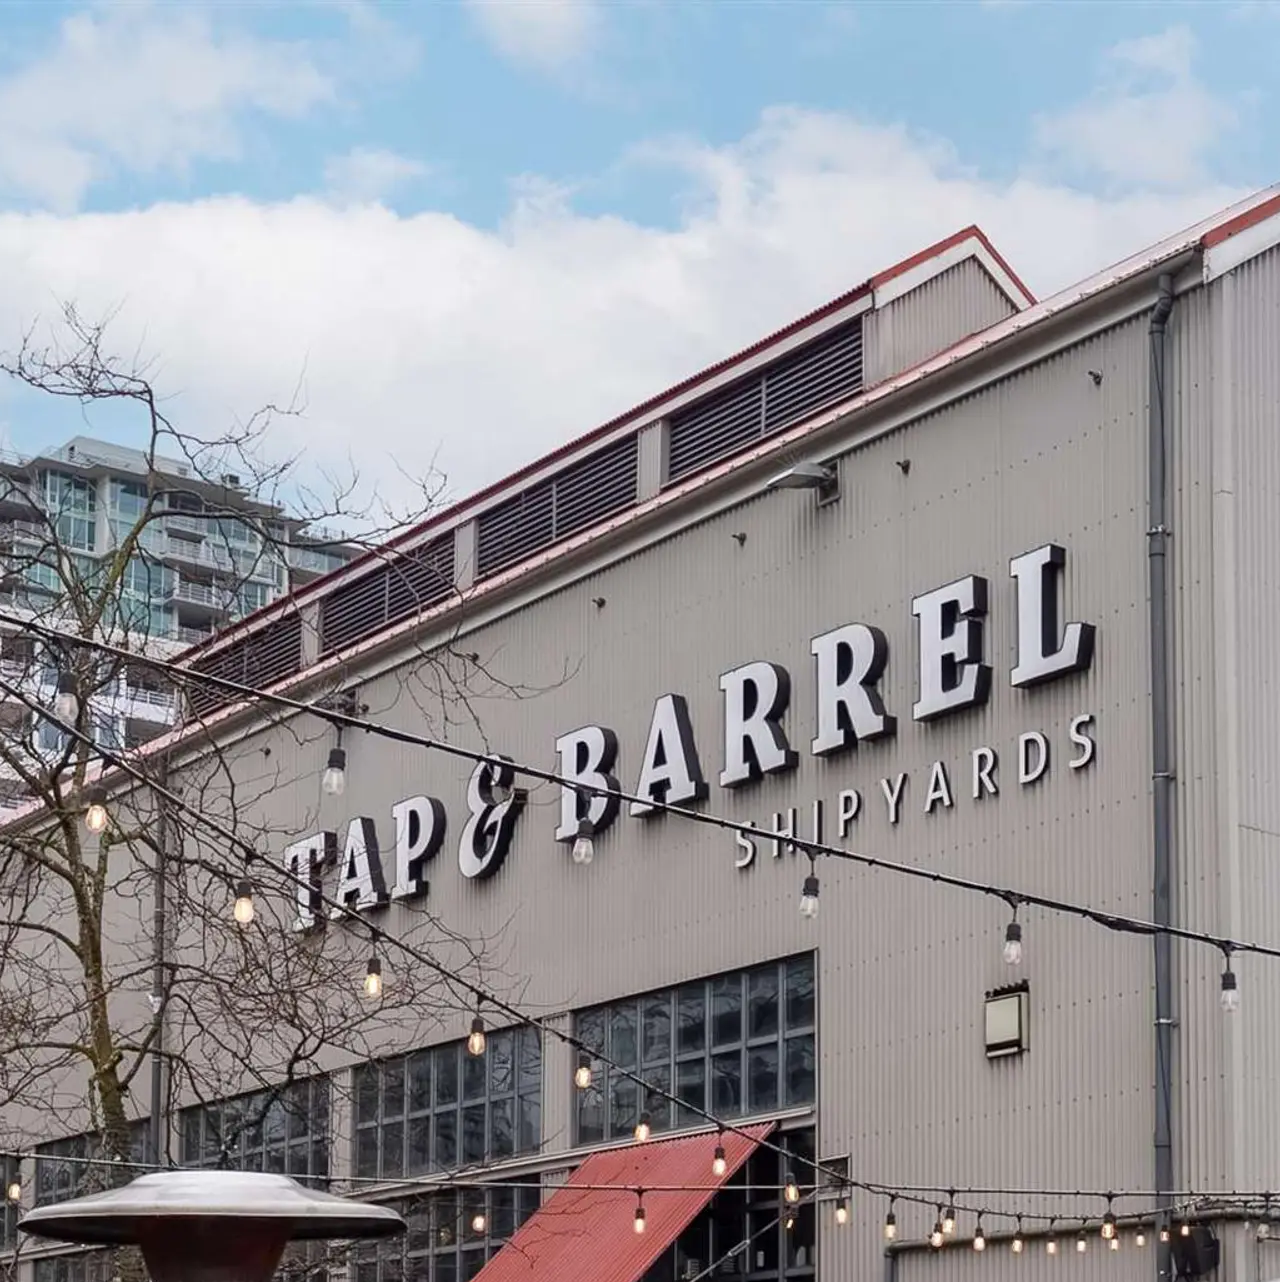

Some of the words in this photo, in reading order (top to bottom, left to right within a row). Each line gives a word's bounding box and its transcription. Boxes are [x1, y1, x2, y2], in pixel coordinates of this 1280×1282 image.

[284, 795, 446, 931] TAP
[458, 755, 528, 879] &
[555, 543, 1095, 842] BARREL
[735, 713, 1096, 869] SHIPYARDS
